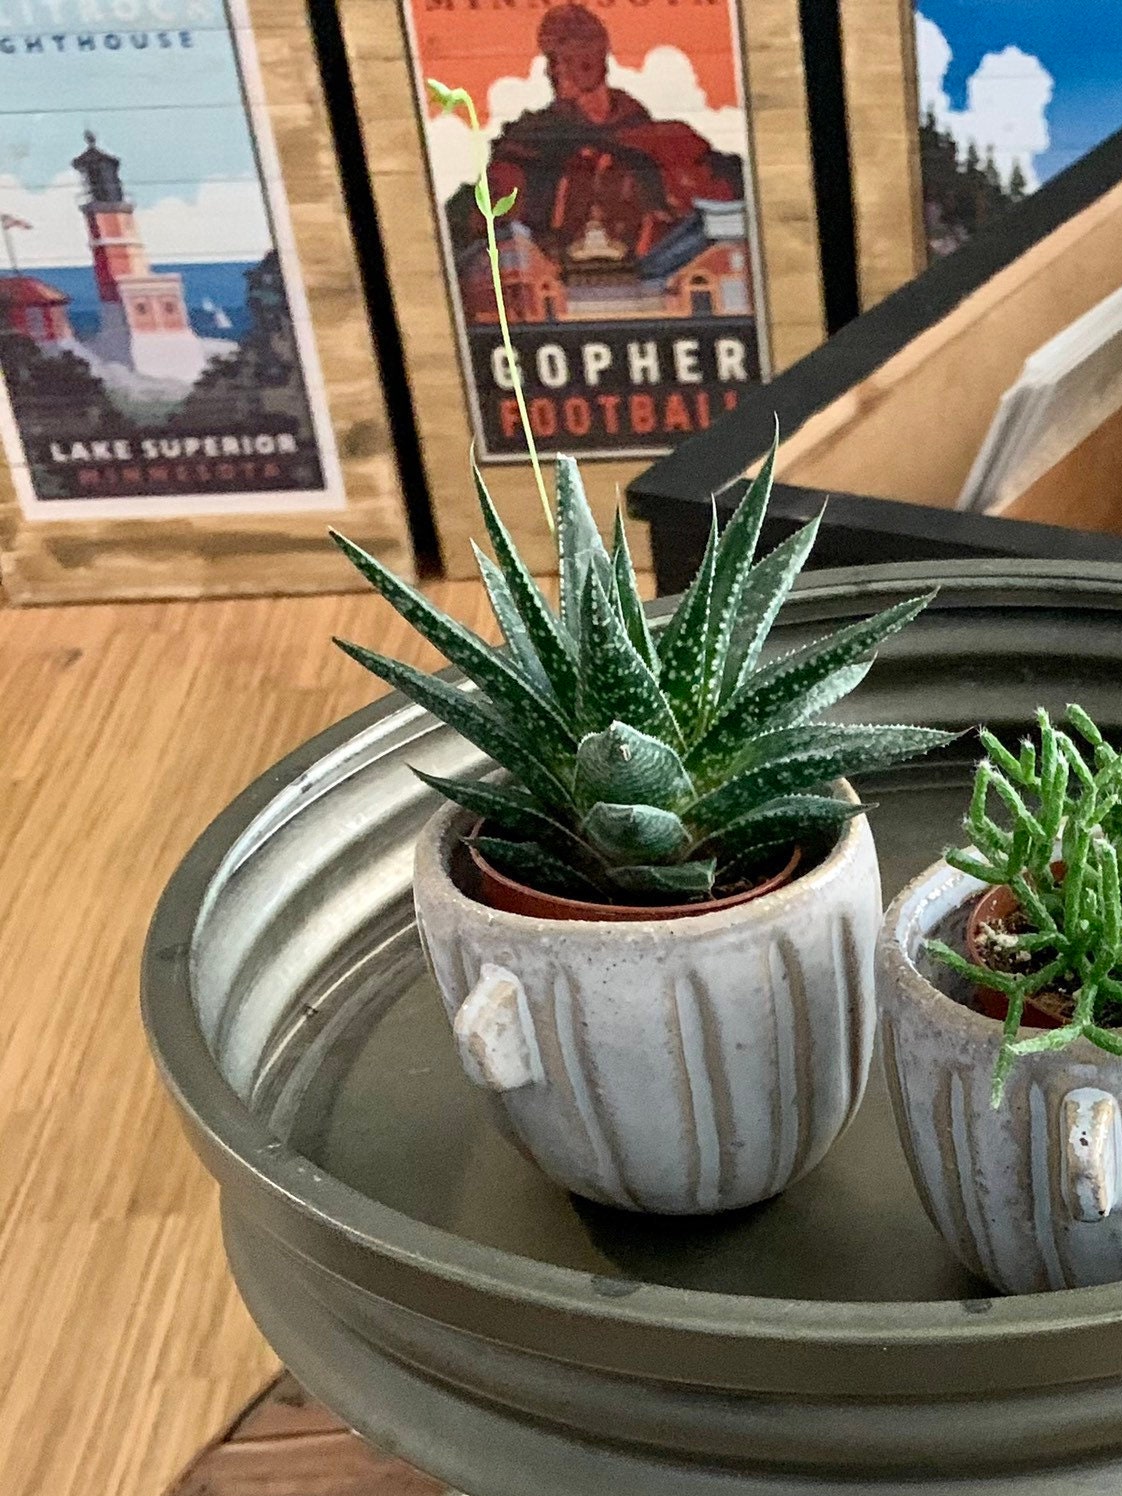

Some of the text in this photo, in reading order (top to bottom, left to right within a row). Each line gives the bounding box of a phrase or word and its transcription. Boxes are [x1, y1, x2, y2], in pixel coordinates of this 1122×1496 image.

[490, 337, 748, 390] GOPHER
[499, 388, 738, 438] FOOTBAL
[51, 433, 297, 463] LAKE SUPERIOR
